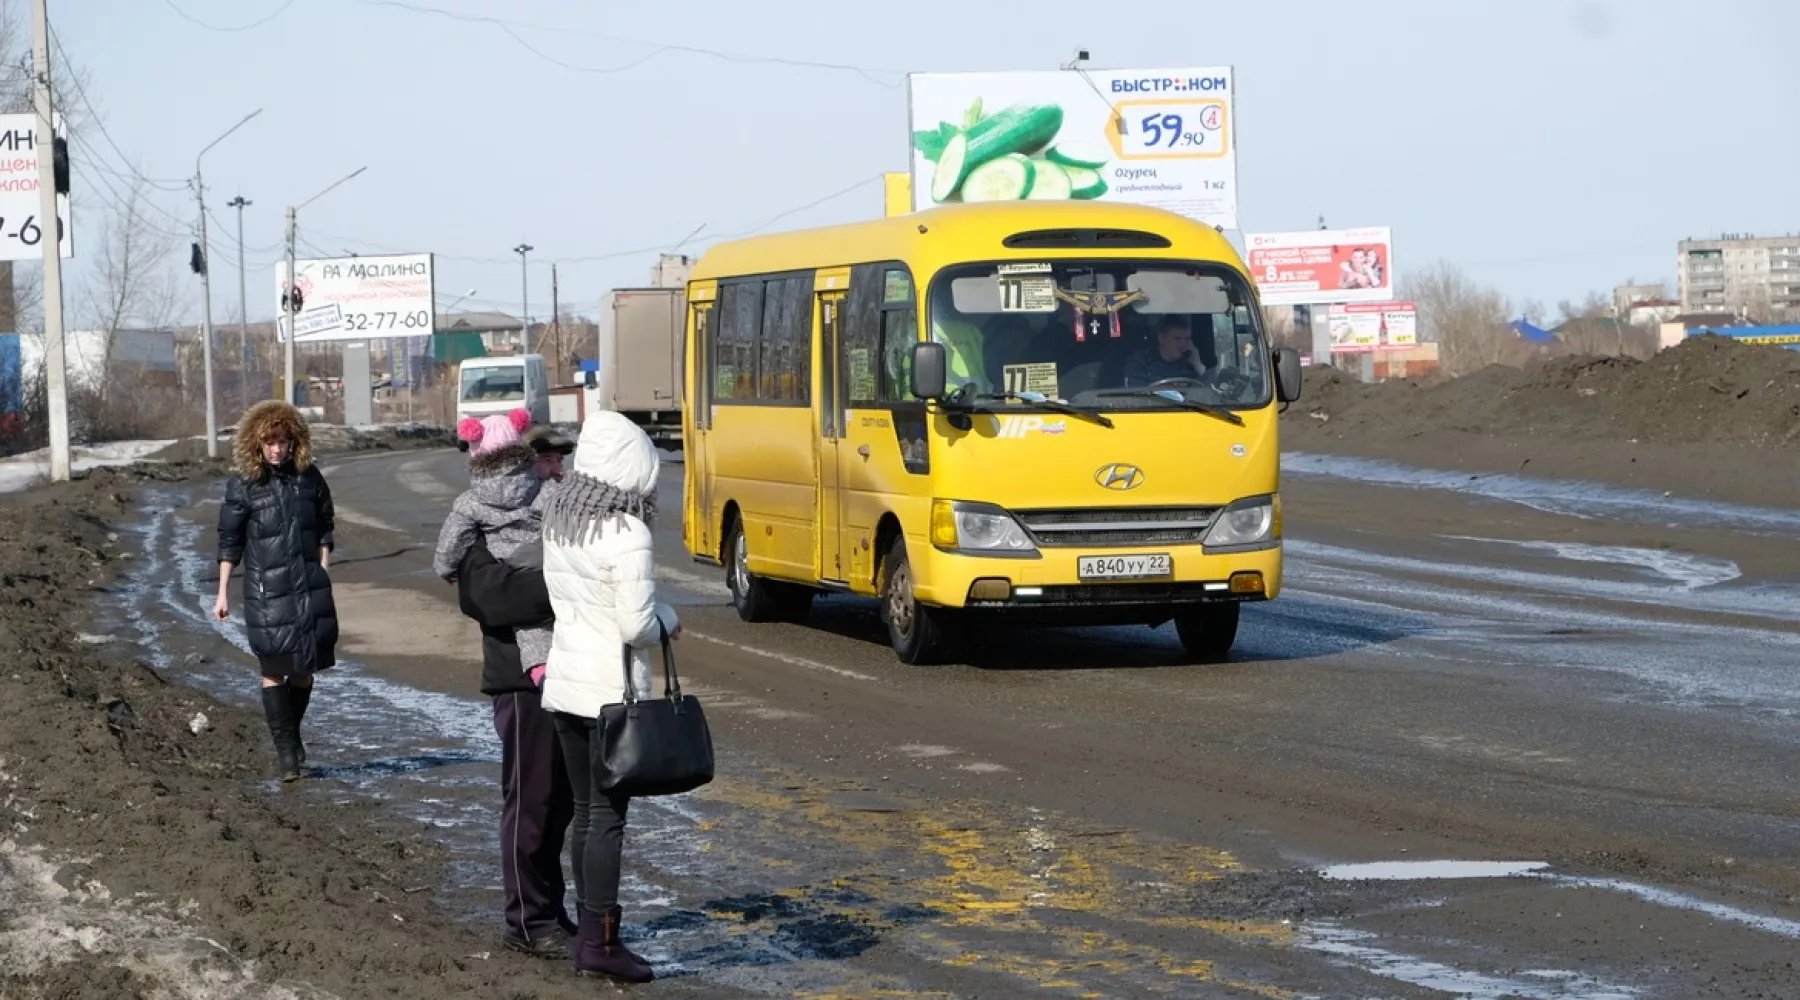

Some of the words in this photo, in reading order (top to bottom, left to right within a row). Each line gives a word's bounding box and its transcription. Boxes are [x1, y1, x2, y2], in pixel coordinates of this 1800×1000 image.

[323, 265, 341, 279] РА
[347, 262, 426, 280] Малина
[344, 310, 429, 332] 32-77-60
[1150, 556, 1164, 568] 22
